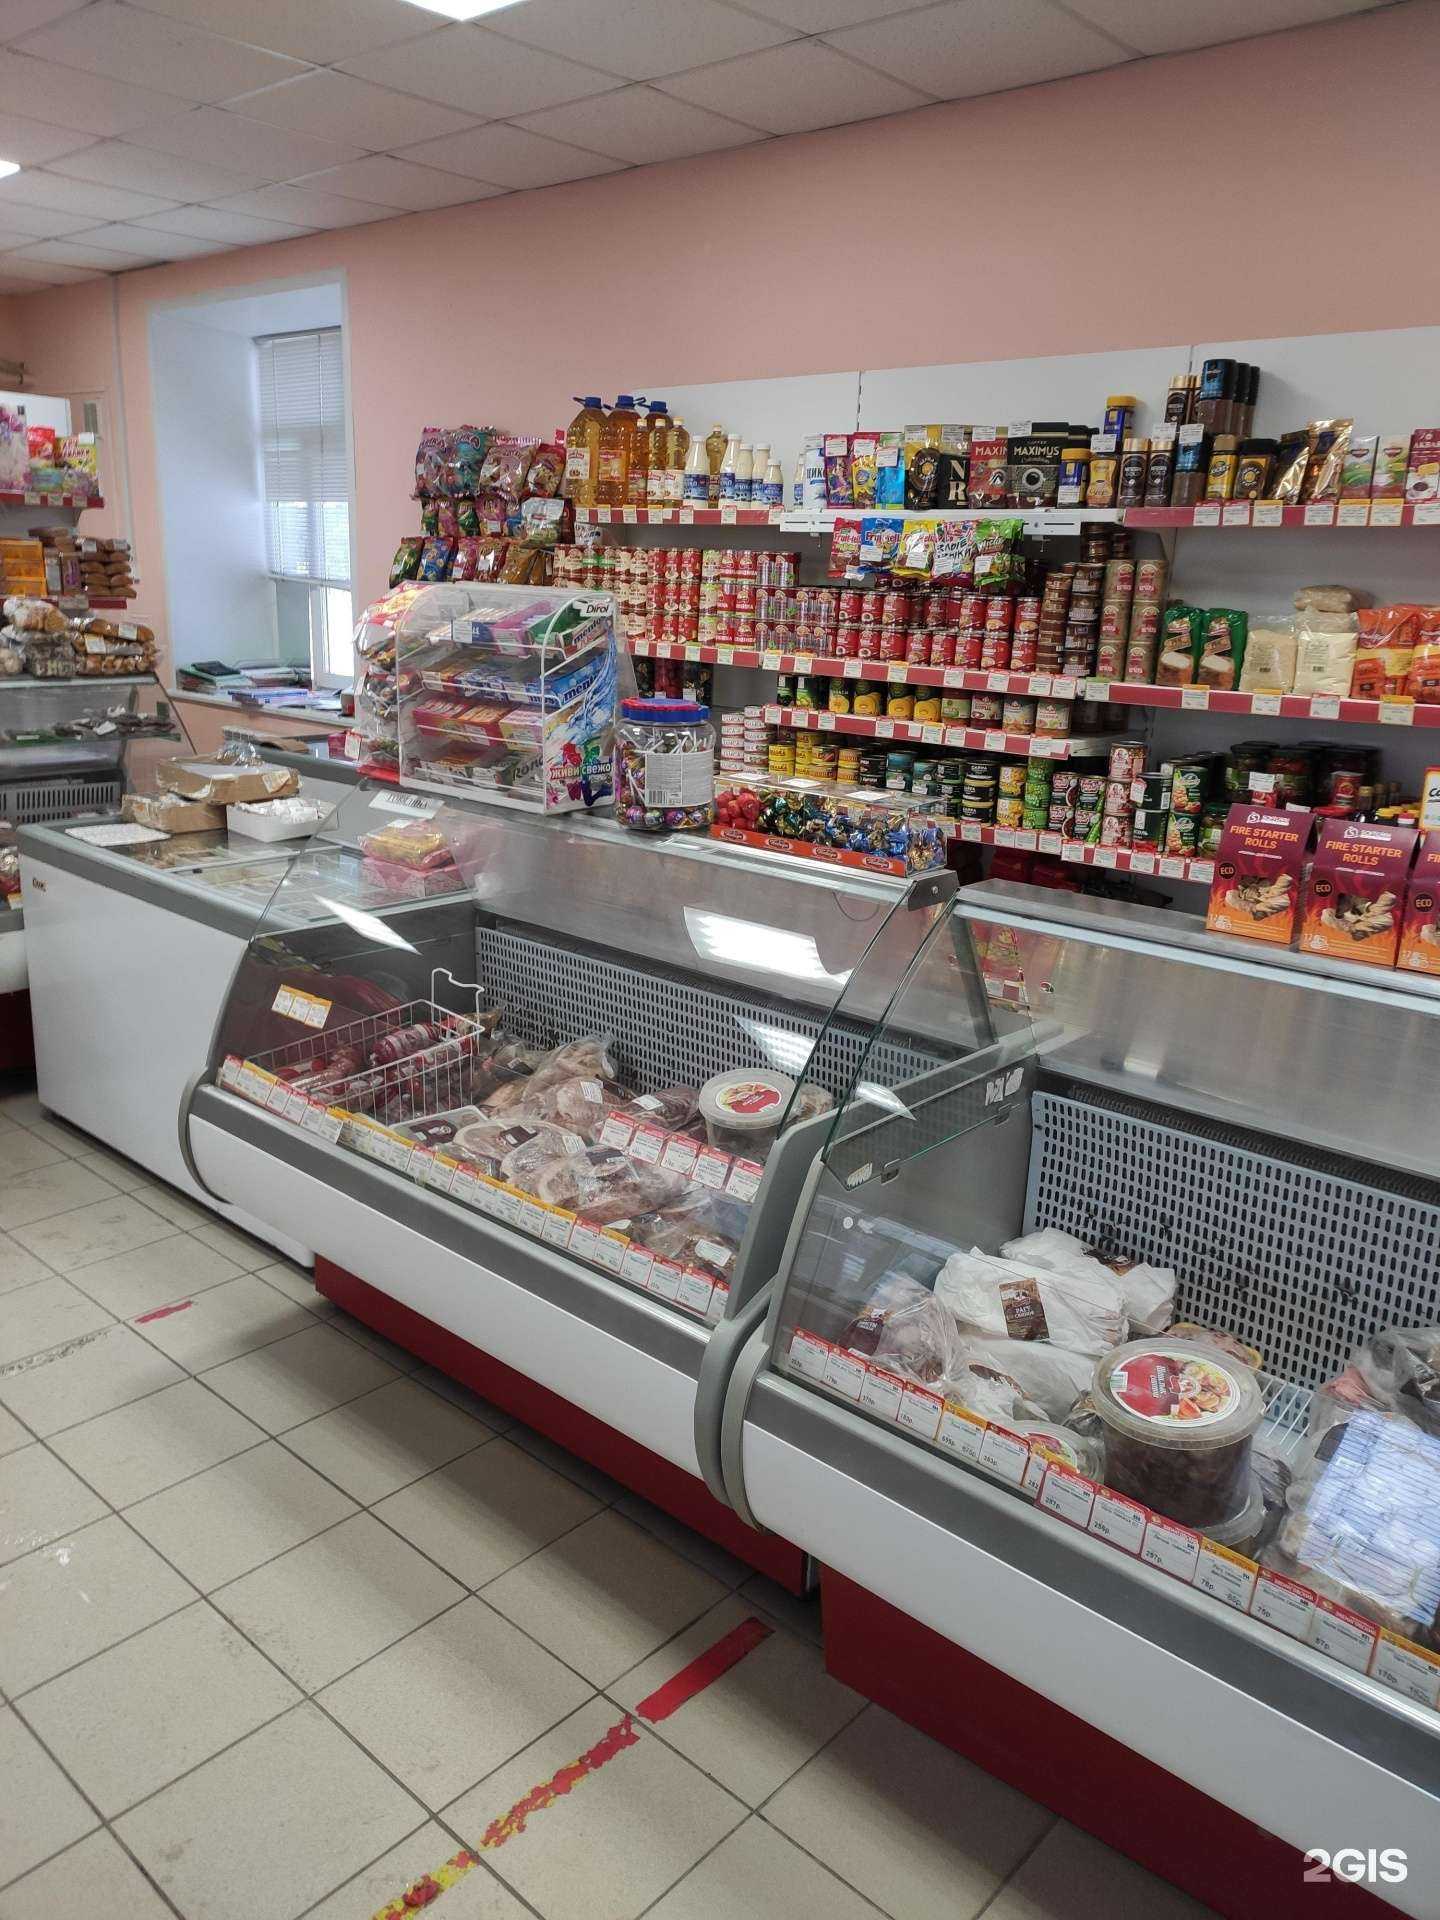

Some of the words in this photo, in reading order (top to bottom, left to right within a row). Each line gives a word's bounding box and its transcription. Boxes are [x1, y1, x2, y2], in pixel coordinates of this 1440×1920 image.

[1013, 446, 1060, 458] MAXIMUS
[806, 467, 825, 479] ЦИК
[586, 604, 609, 614] Dirol
[573, 616, 604, 644] mento
[1231, 825, 1251, 836] FIRE
[1252, 828, 1299, 843] STARTER
[1244, 837, 1277, 849] ROLLS
[1326, 841, 1348, 852] FIRE
[1348, 843, 1403, 858] STARTER
[1343, 853, 1378, 866] ROLLS
[1427, 853, 1440, 863] FI
[1220, 867, 1234, 875] ECO
[1315, 884, 1331, 893] ECO
[1416, 899, 1432, 907] ECO
